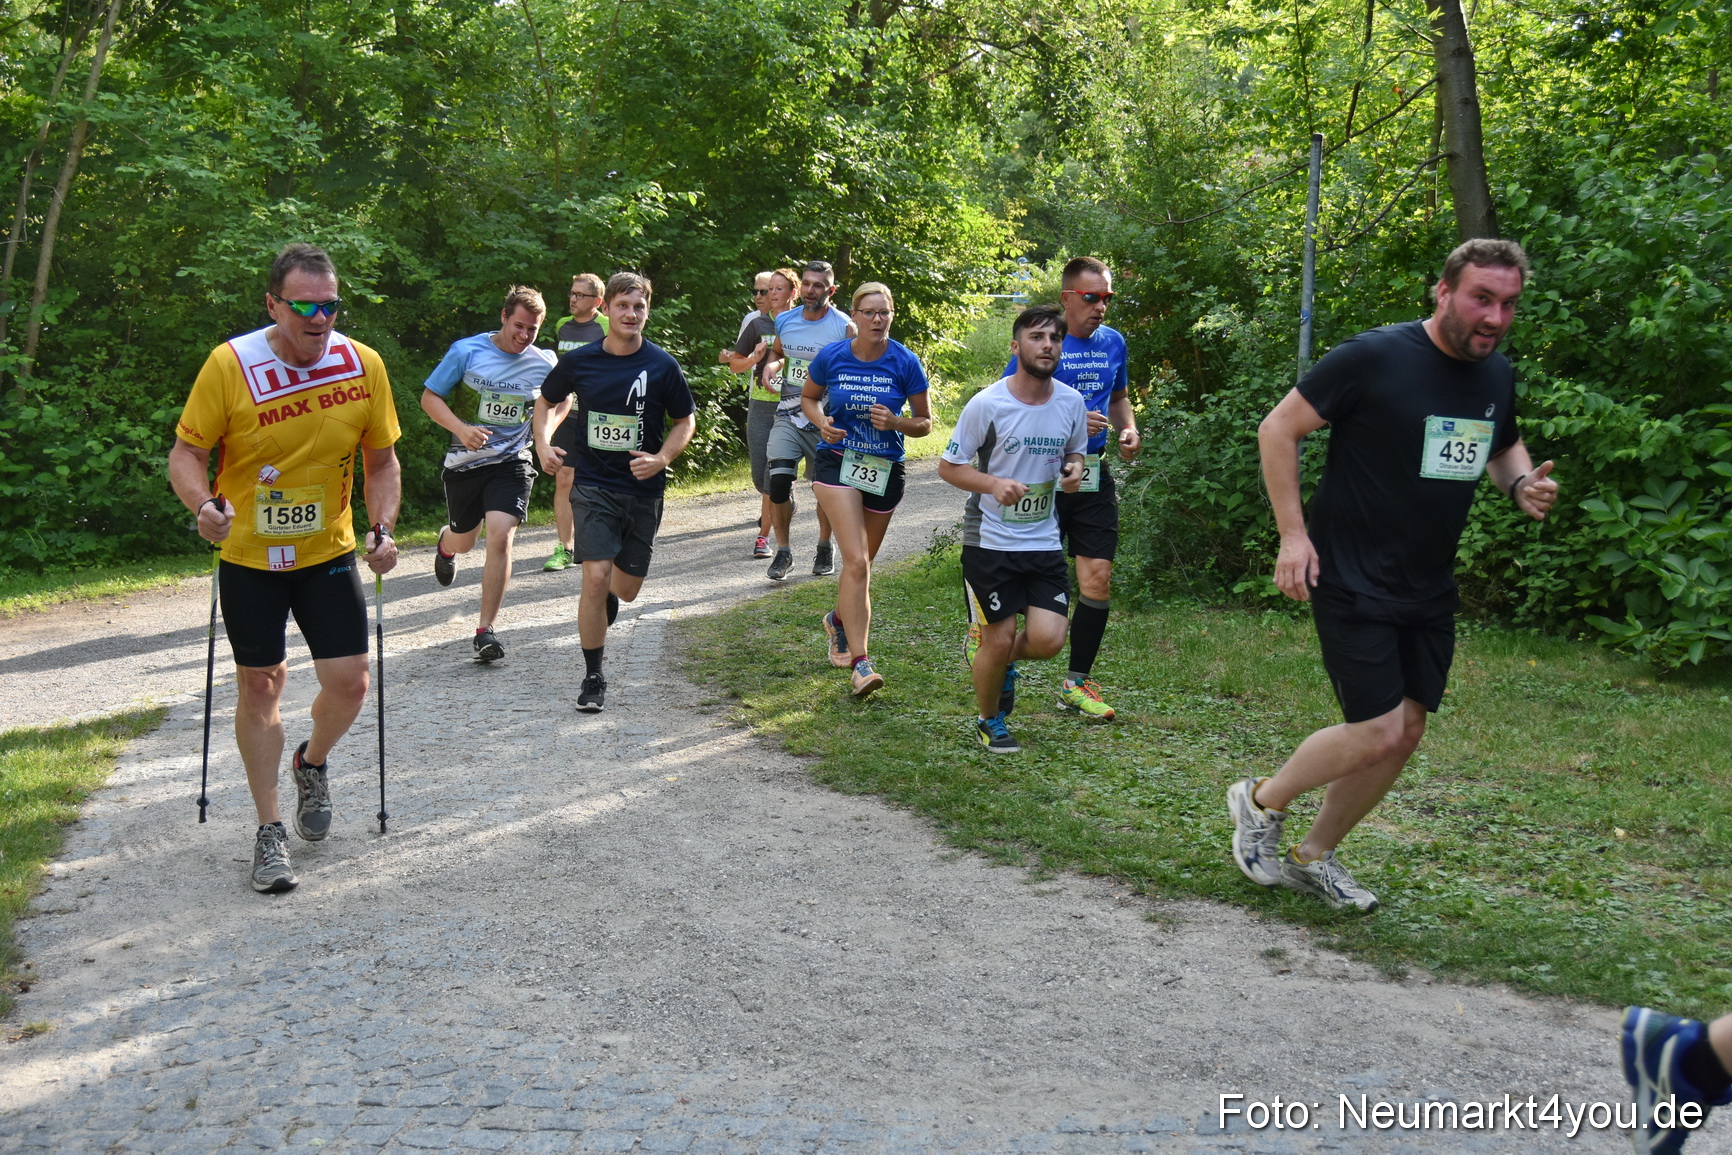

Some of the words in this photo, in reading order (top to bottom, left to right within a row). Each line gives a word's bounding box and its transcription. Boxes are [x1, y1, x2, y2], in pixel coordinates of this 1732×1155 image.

[1060, 351, 1082, 360] Wenn
[1091, 350, 1108, 358] beim
[1062, 360, 1109, 371] Hausverkauf
[838, 373, 861, 382] Wenn
[872, 374, 893, 384] beim
[1077, 371, 1100, 381] richtig
[473, 377, 522, 391] RAIL.ONE
[839, 382, 891, 393] Hausverkauf
[850, 393, 877, 404] richtig
[258, 398, 313, 428] MAX
[317, 385, 371, 410] BÖGL
[485, 402, 518, 418] 1946
[593, 425, 631, 442] 1934
[842, 437, 889, 450] FELDBUSCH
[1024, 436, 1065, 447] HAUBNER
[1028, 447, 1060, 456] TREPPEN
[1439, 440, 1478, 464] 435
[851, 463, 878, 483] 733
[263, 504, 317, 525] 1588
[988, 591, 1002, 611] 3
